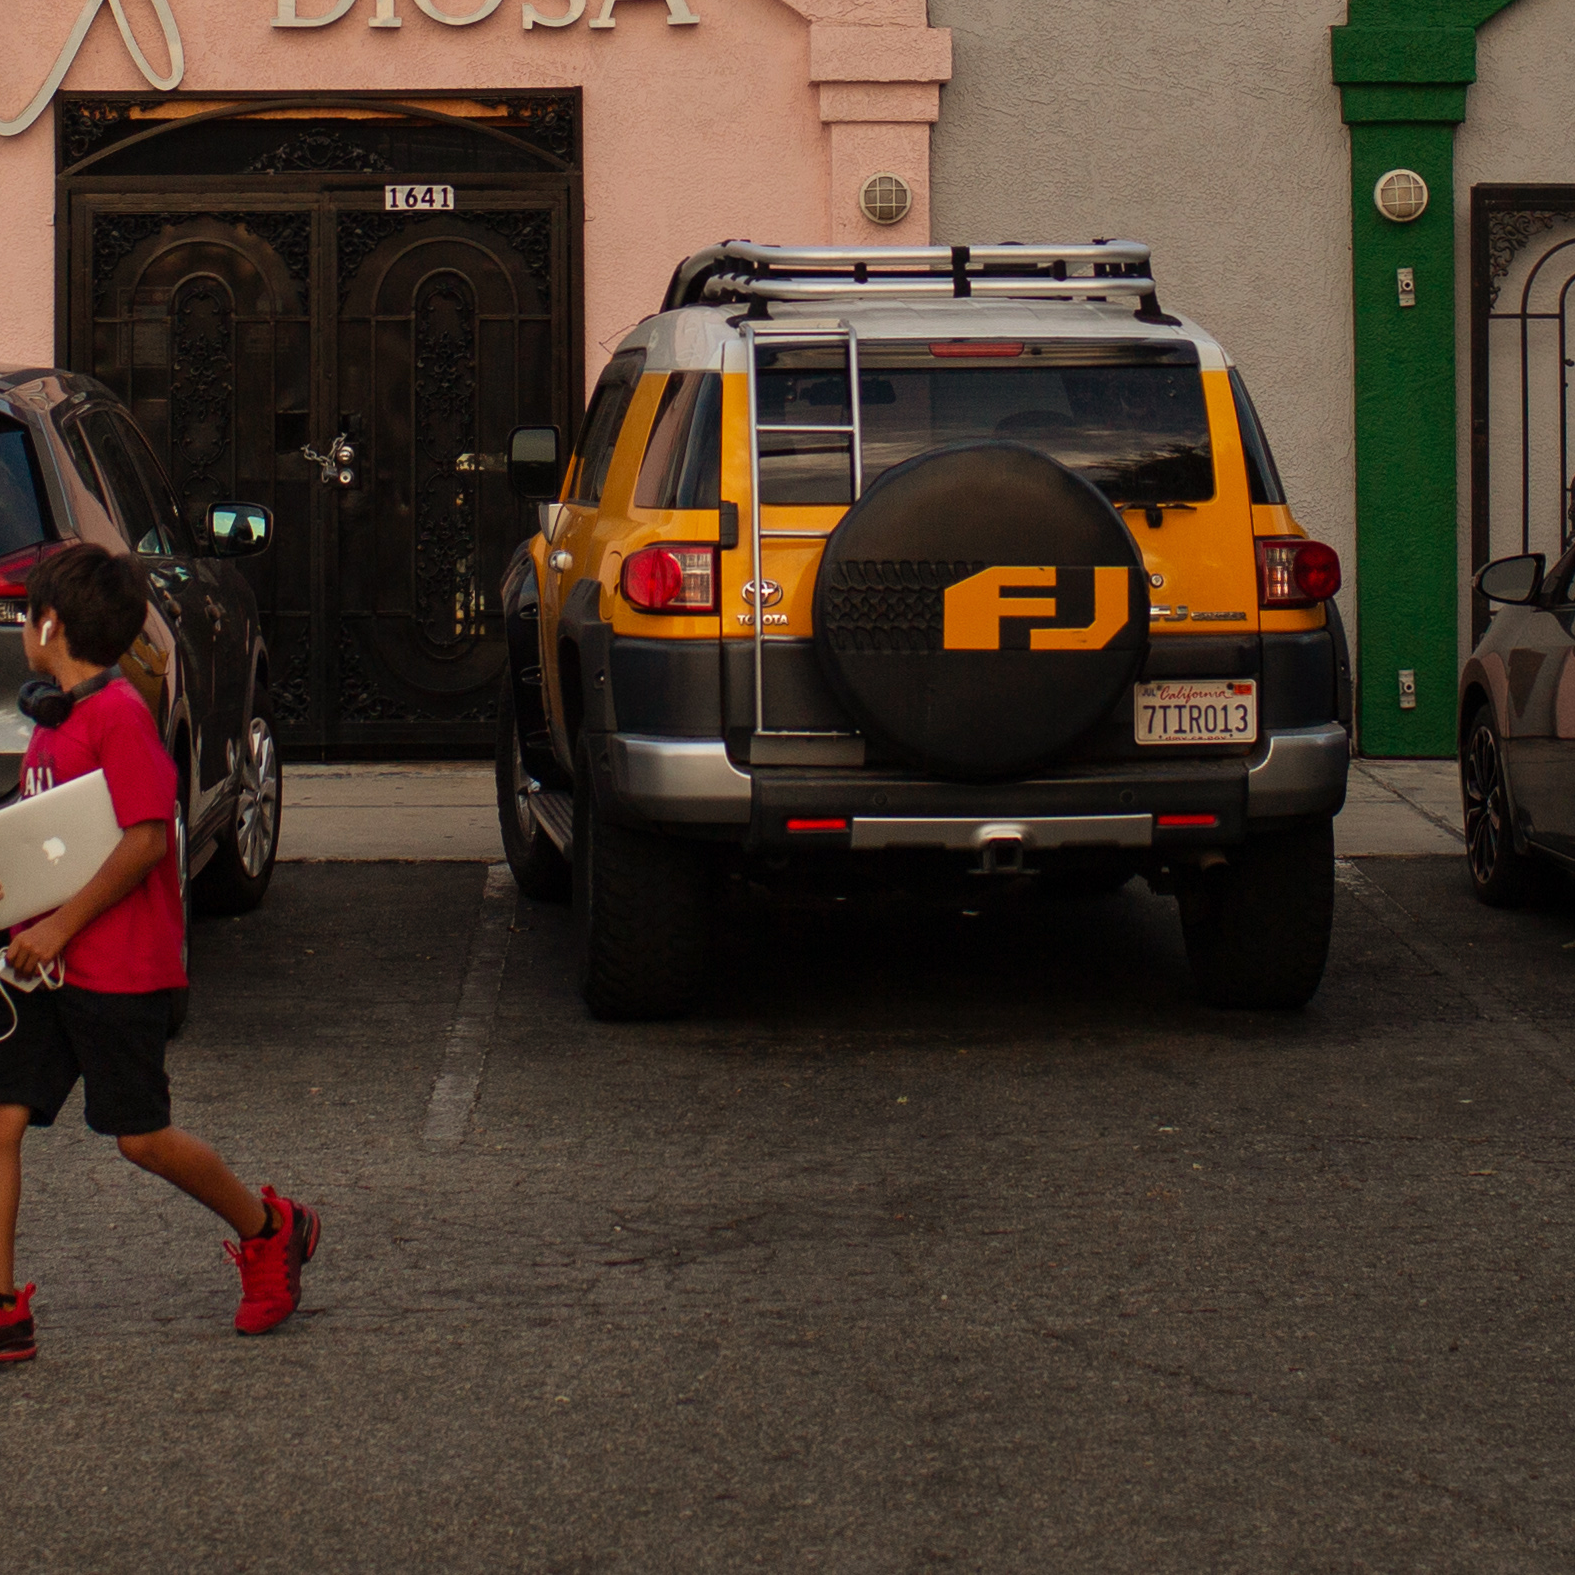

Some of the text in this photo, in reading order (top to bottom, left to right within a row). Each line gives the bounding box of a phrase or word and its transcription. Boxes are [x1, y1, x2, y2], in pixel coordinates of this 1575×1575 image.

[390, 187, 450, 208] 1641
[942, 566, 1128, 650] FJ
[737, 614, 789, 626] TOOTA
[1160, 686, 1233, 704] California
[1143, 704, 1248, 734] 7TIR013
